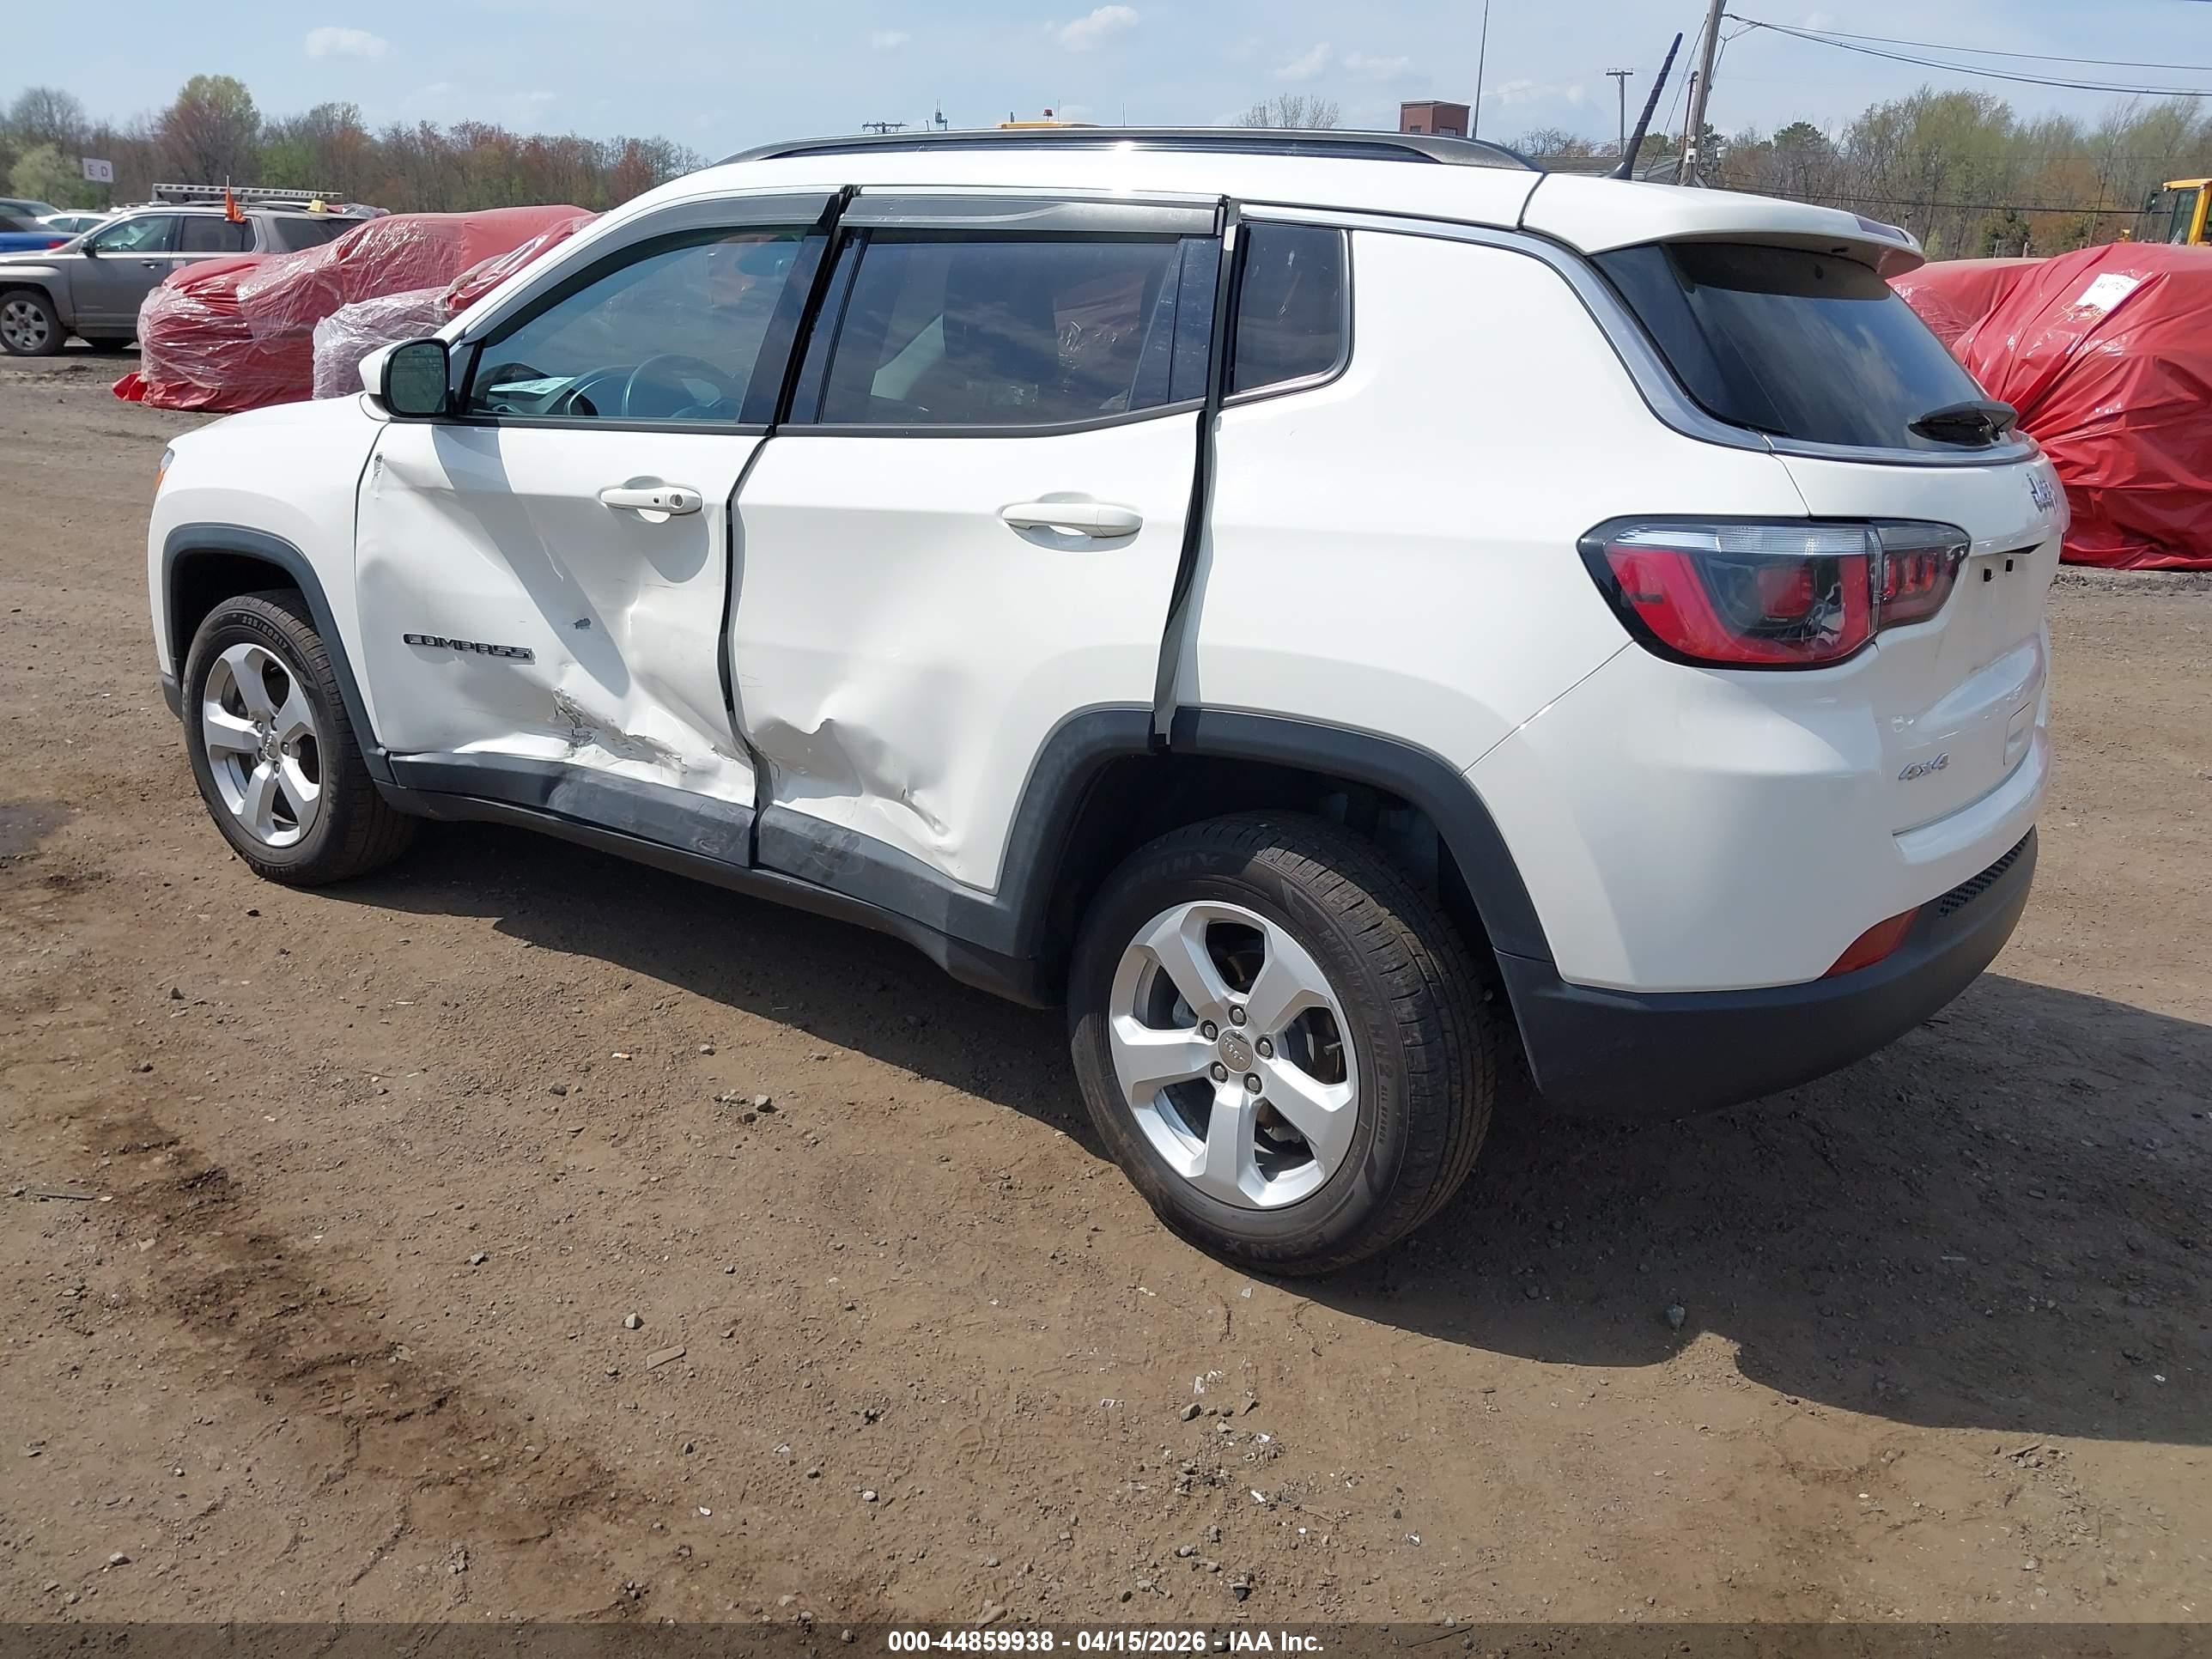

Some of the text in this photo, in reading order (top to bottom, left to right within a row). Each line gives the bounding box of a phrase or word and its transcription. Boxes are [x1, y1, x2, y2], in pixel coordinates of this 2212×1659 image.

[88, 164, 109, 177] E D
[403, 633, 535, 659] COMPASS
